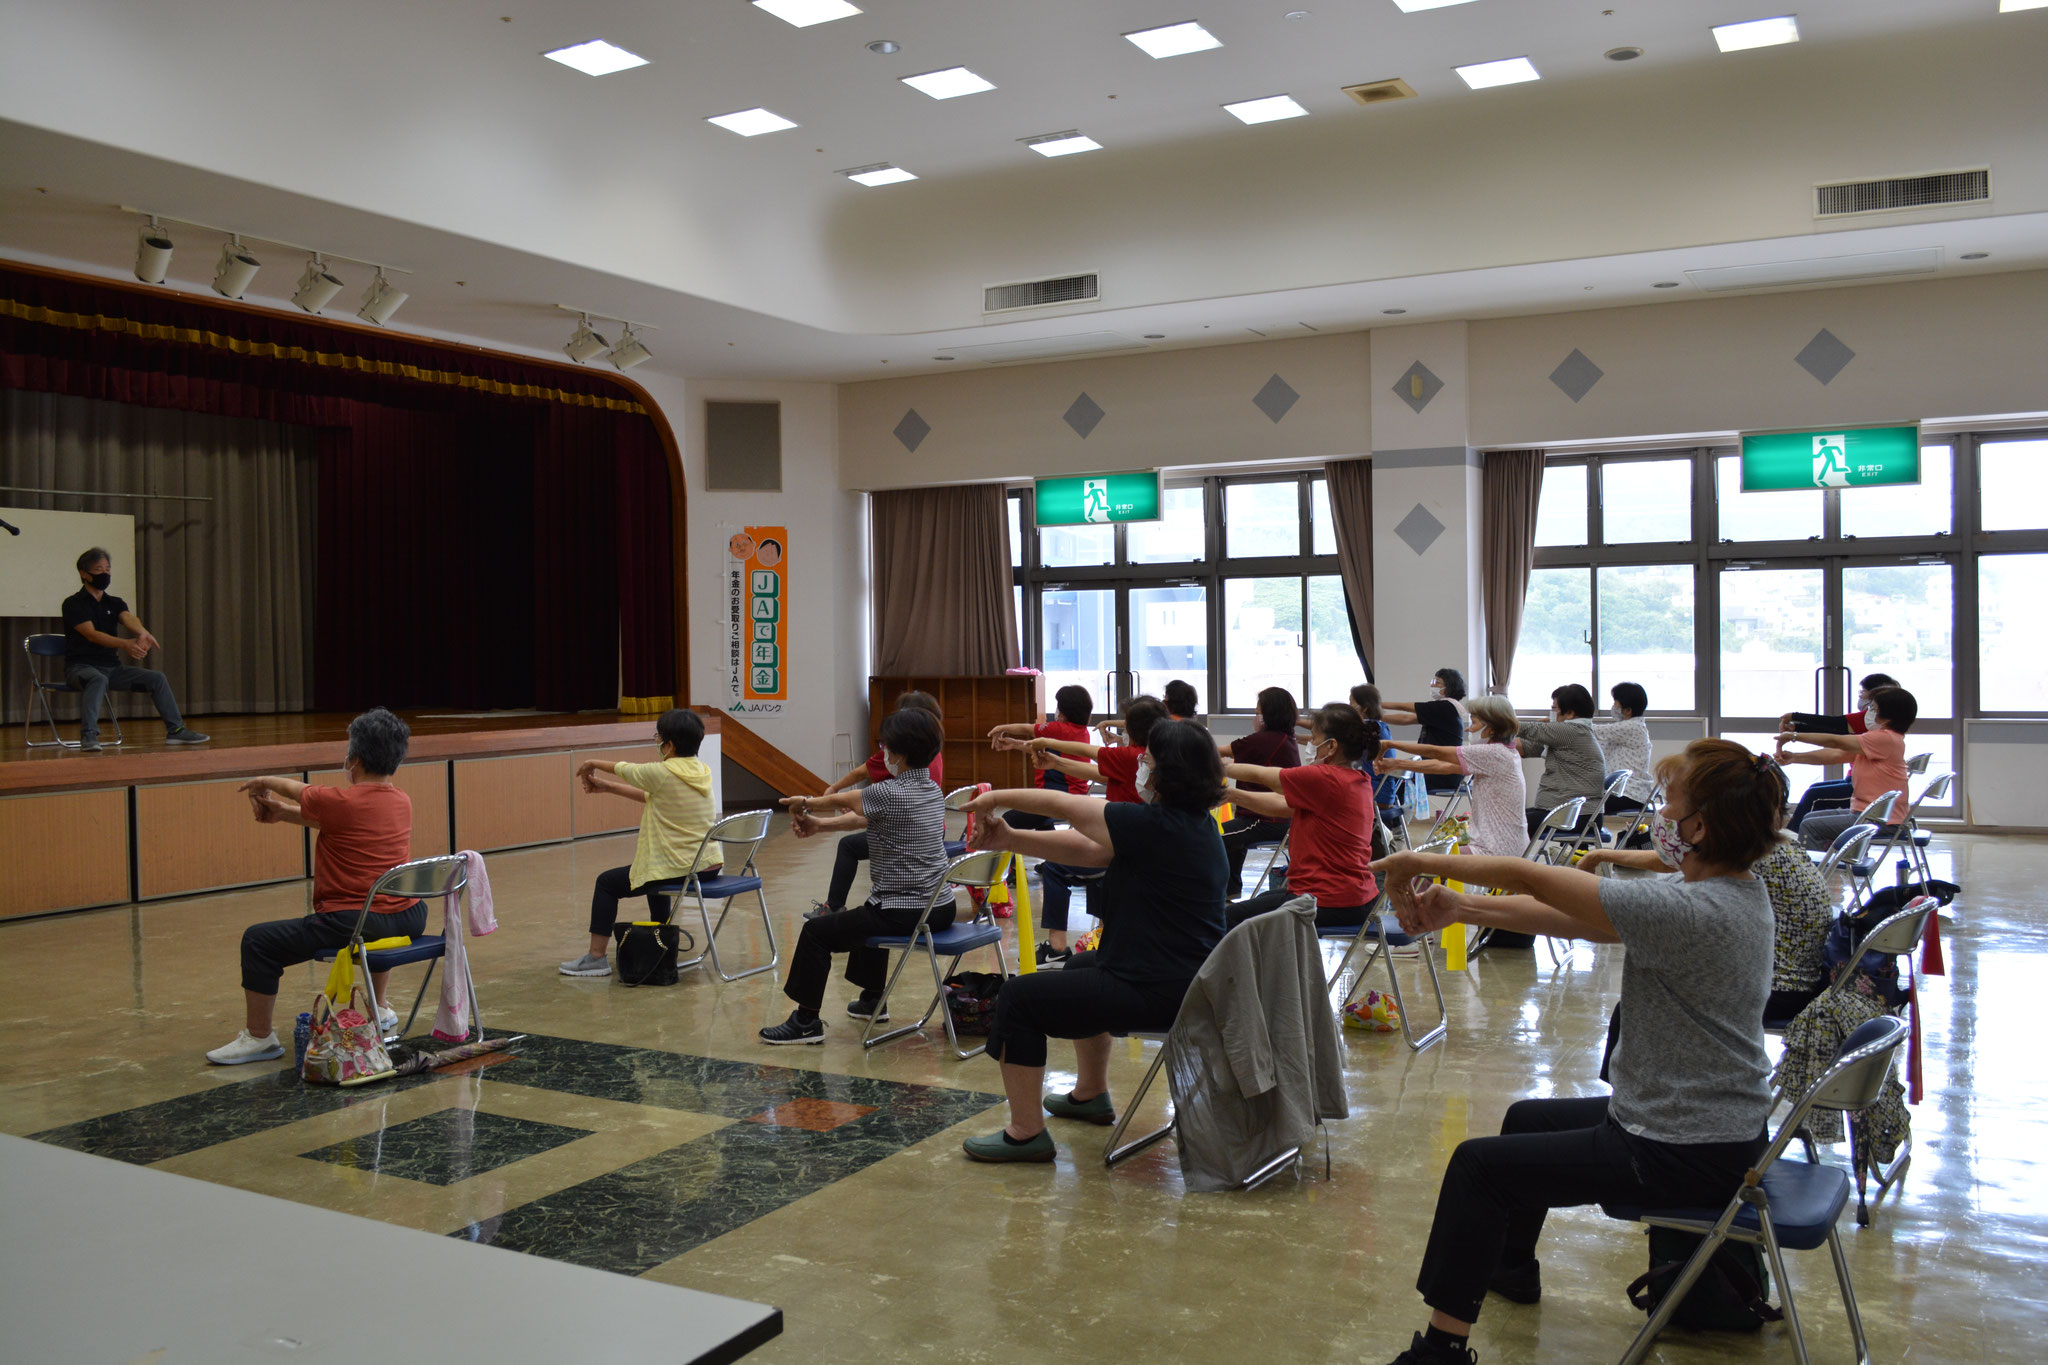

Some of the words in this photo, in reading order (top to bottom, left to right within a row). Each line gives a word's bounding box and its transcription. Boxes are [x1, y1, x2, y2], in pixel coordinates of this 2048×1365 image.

[1858, 464, 1883, 472] 非常口
[755, 574, 771, 686] JAで年金
[748, 704, 782, 713] JAバンク
